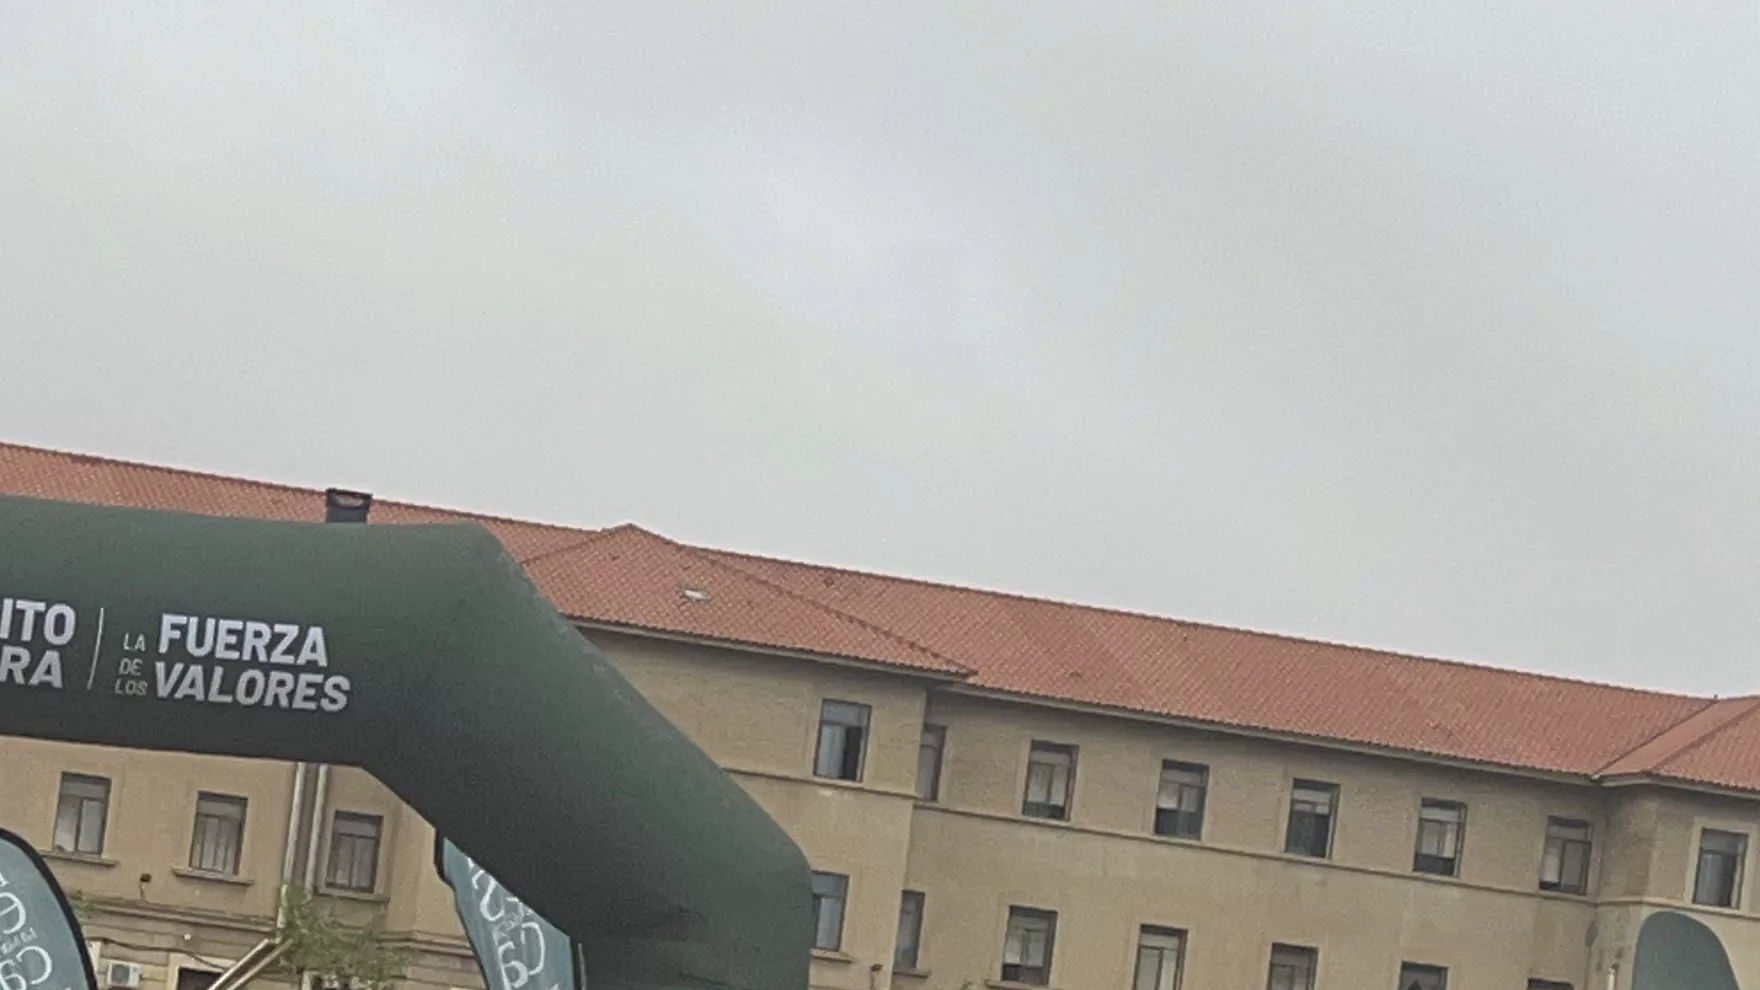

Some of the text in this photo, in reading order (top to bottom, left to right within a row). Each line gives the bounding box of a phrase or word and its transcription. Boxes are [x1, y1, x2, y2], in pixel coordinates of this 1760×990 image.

[123, 612, 328, 668] LA FUERZA
[114, 660, 352, 713] LOS VALORES
[119, 657, 142, 677] DE
